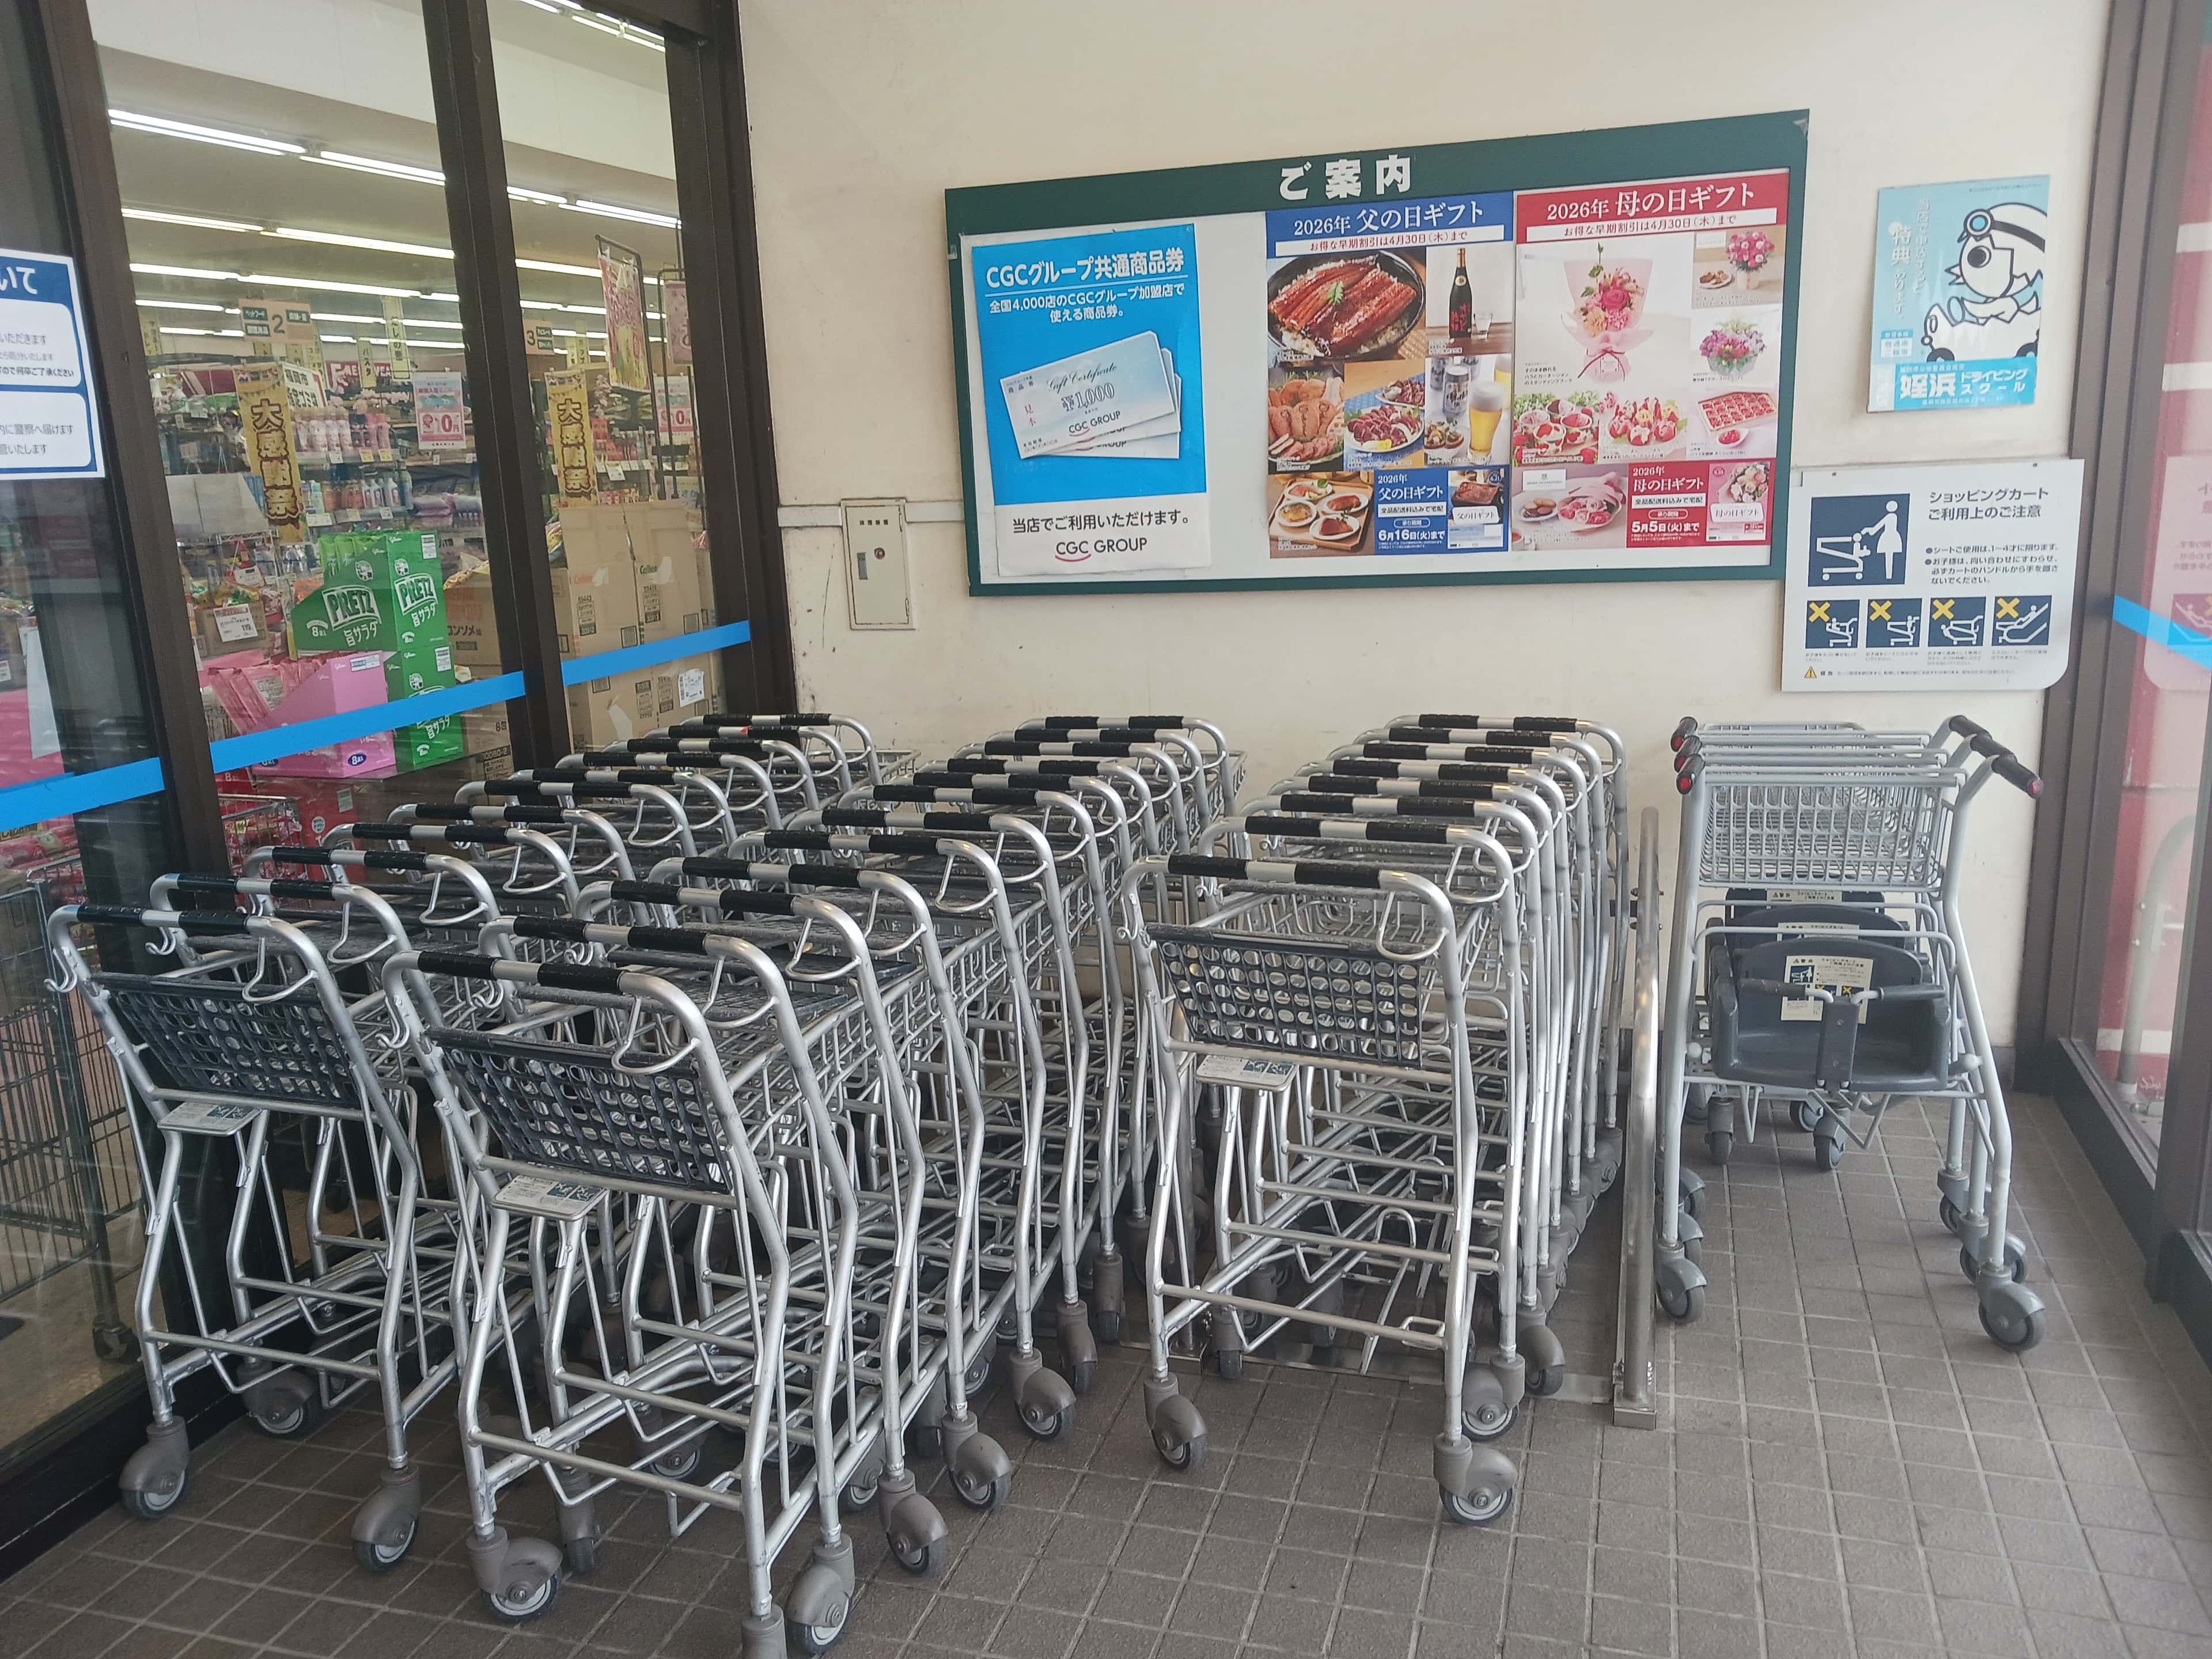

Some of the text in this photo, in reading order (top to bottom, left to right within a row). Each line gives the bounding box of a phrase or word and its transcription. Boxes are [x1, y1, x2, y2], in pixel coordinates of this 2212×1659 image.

[1279, 154, 1411, 201] ご案内
[1547, 182, 1754, 221] 2026年 母の日ギフト
[1293, 200, 1483, 236] 2026年 父の日ギフト
[986, 247, 1185, 289] CGCグループ共通商品券
[989, 283, 1185, 315] 全国4,000店のCGCグループ加盟店で
[272, 314, 285, 334] 2
[1050, 305, 1124, 324] 使える商品券。
[527, 330, 535, 346] 3
[1900, 372, 1956, 400] 姪浜
[1961, 381, 2026, 395] スクール
[1069, 411, 1121, 434] CGC GROUP
[1378, 485, 1443, 501] 父の日ギフト
[1633, 477, 1704, 493] 母の日ギフト
[1930, 487, 2048, 503] ショッピングカート
[1013, 509, 1189, 535] 当店でご利用いただけます。
[1929, 505, 2041, 521] ご利用上のご注意
[1055, 537, 1148, 555] CGC GROUP
[398, 577, 434, 608] PRETZ
[327, 590, 374, 623] PRETZ
